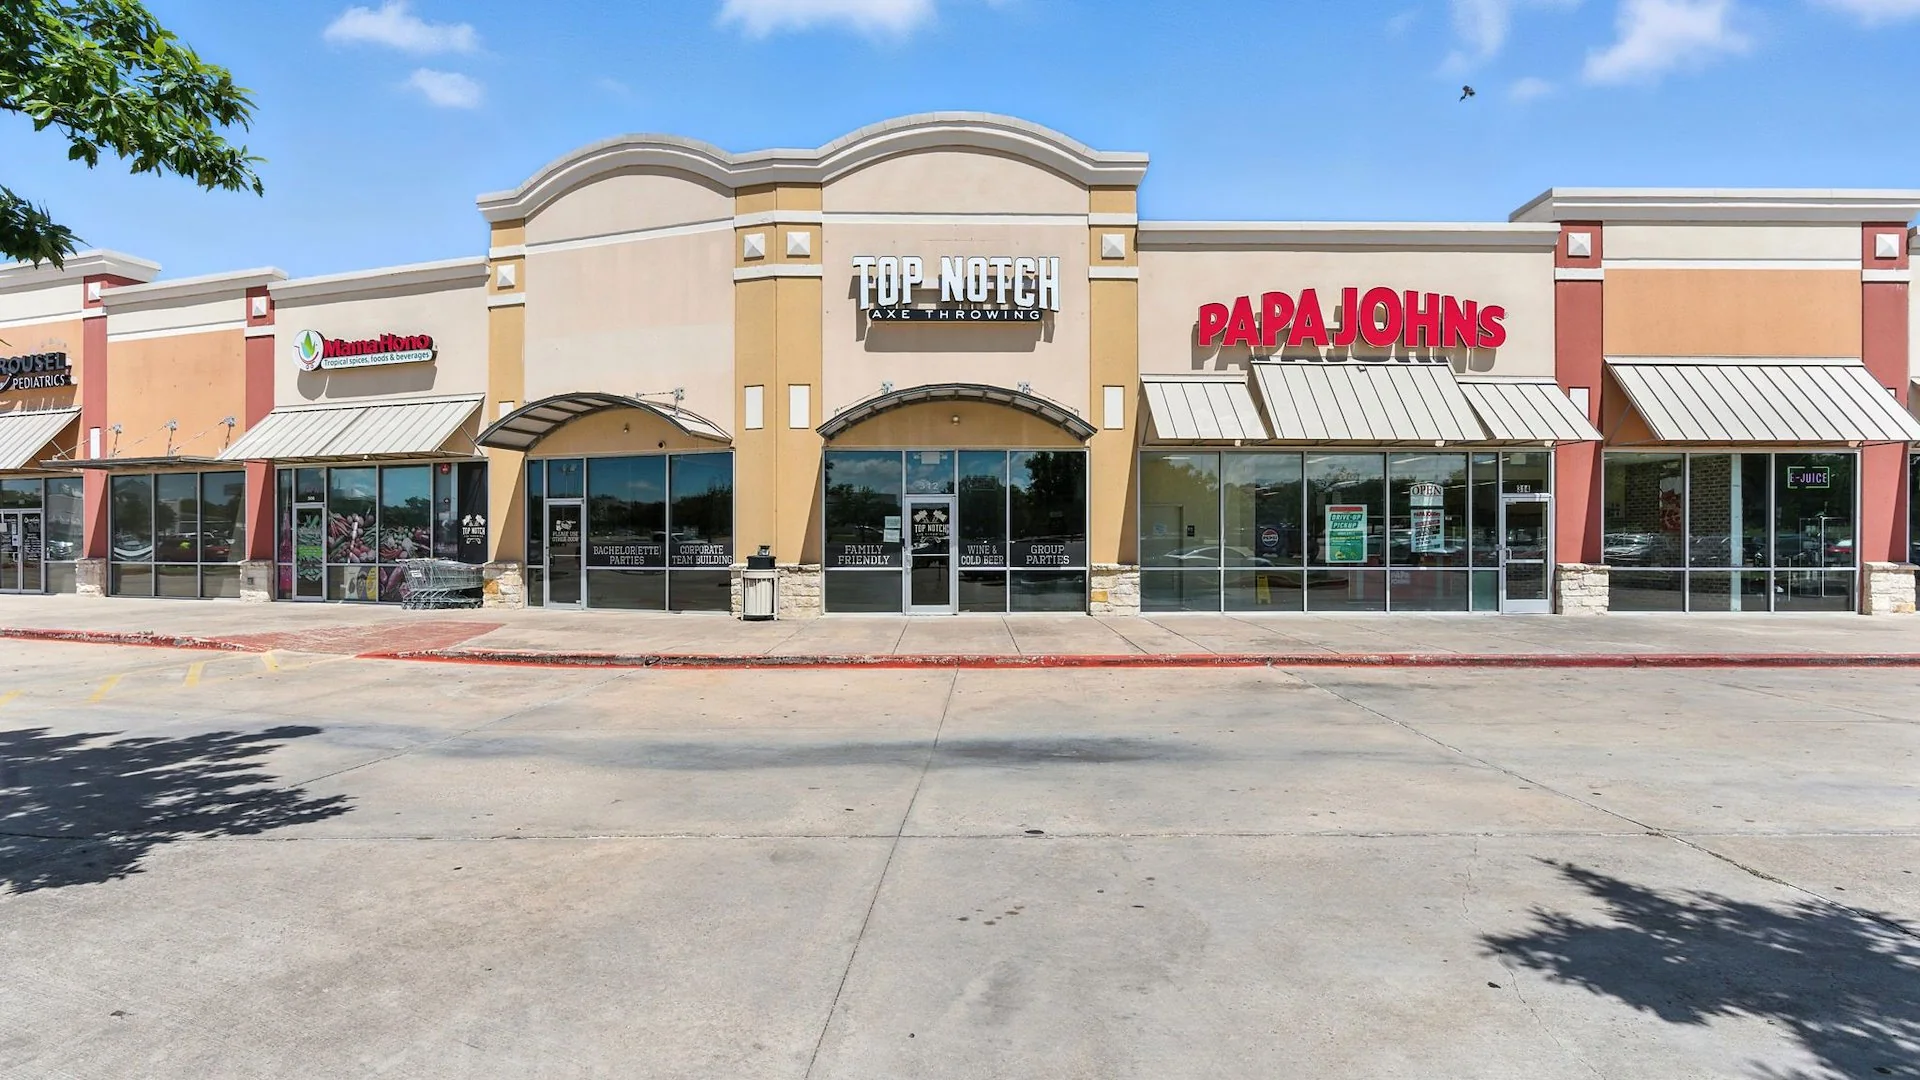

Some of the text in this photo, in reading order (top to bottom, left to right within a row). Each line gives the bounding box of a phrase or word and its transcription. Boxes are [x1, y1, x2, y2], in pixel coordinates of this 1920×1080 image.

[852, 255, 1061, 313] TOP NOTCH
[872, 309, 1041, 320] AXE THROWING
[1198, 286, 1507, 349] PAPA JOHNS
[323, 333, 431, 358] MamaHono
[324, 350, 430, 367] Tropical spices, foods & beverages
[13, 374, 65, 390] PEDIATRICS
[1790, 472, 1828, 484] E-JUICE
[919, 482, 939, 490] 312
[1412, 485, 1442, 496] OPEN
[1331, 513, 1362, 521] DRIVE-UP
[462, 527, 471, 536] TOP
[914, 524, 947, 533] TOP NOTCH
[593, 545, 662, 556] BACHELOR(ETTE)
[680, 545, 724, 555] CORPORATE
[844, 544, 883, 555] FAMILY
[967, 545, 998, 555] WINE &
[1030, 544, 1065, 555] GROUP
[609, 556, 645, 565] PARTIES
[672, 555, 733, 565] TEAM BUILDING
[838, 555, 890, 565] FRIENDLY
[961, 555, 1004, 565] COLD BEER
[1025, 555, 1070, 565] PARTIES
